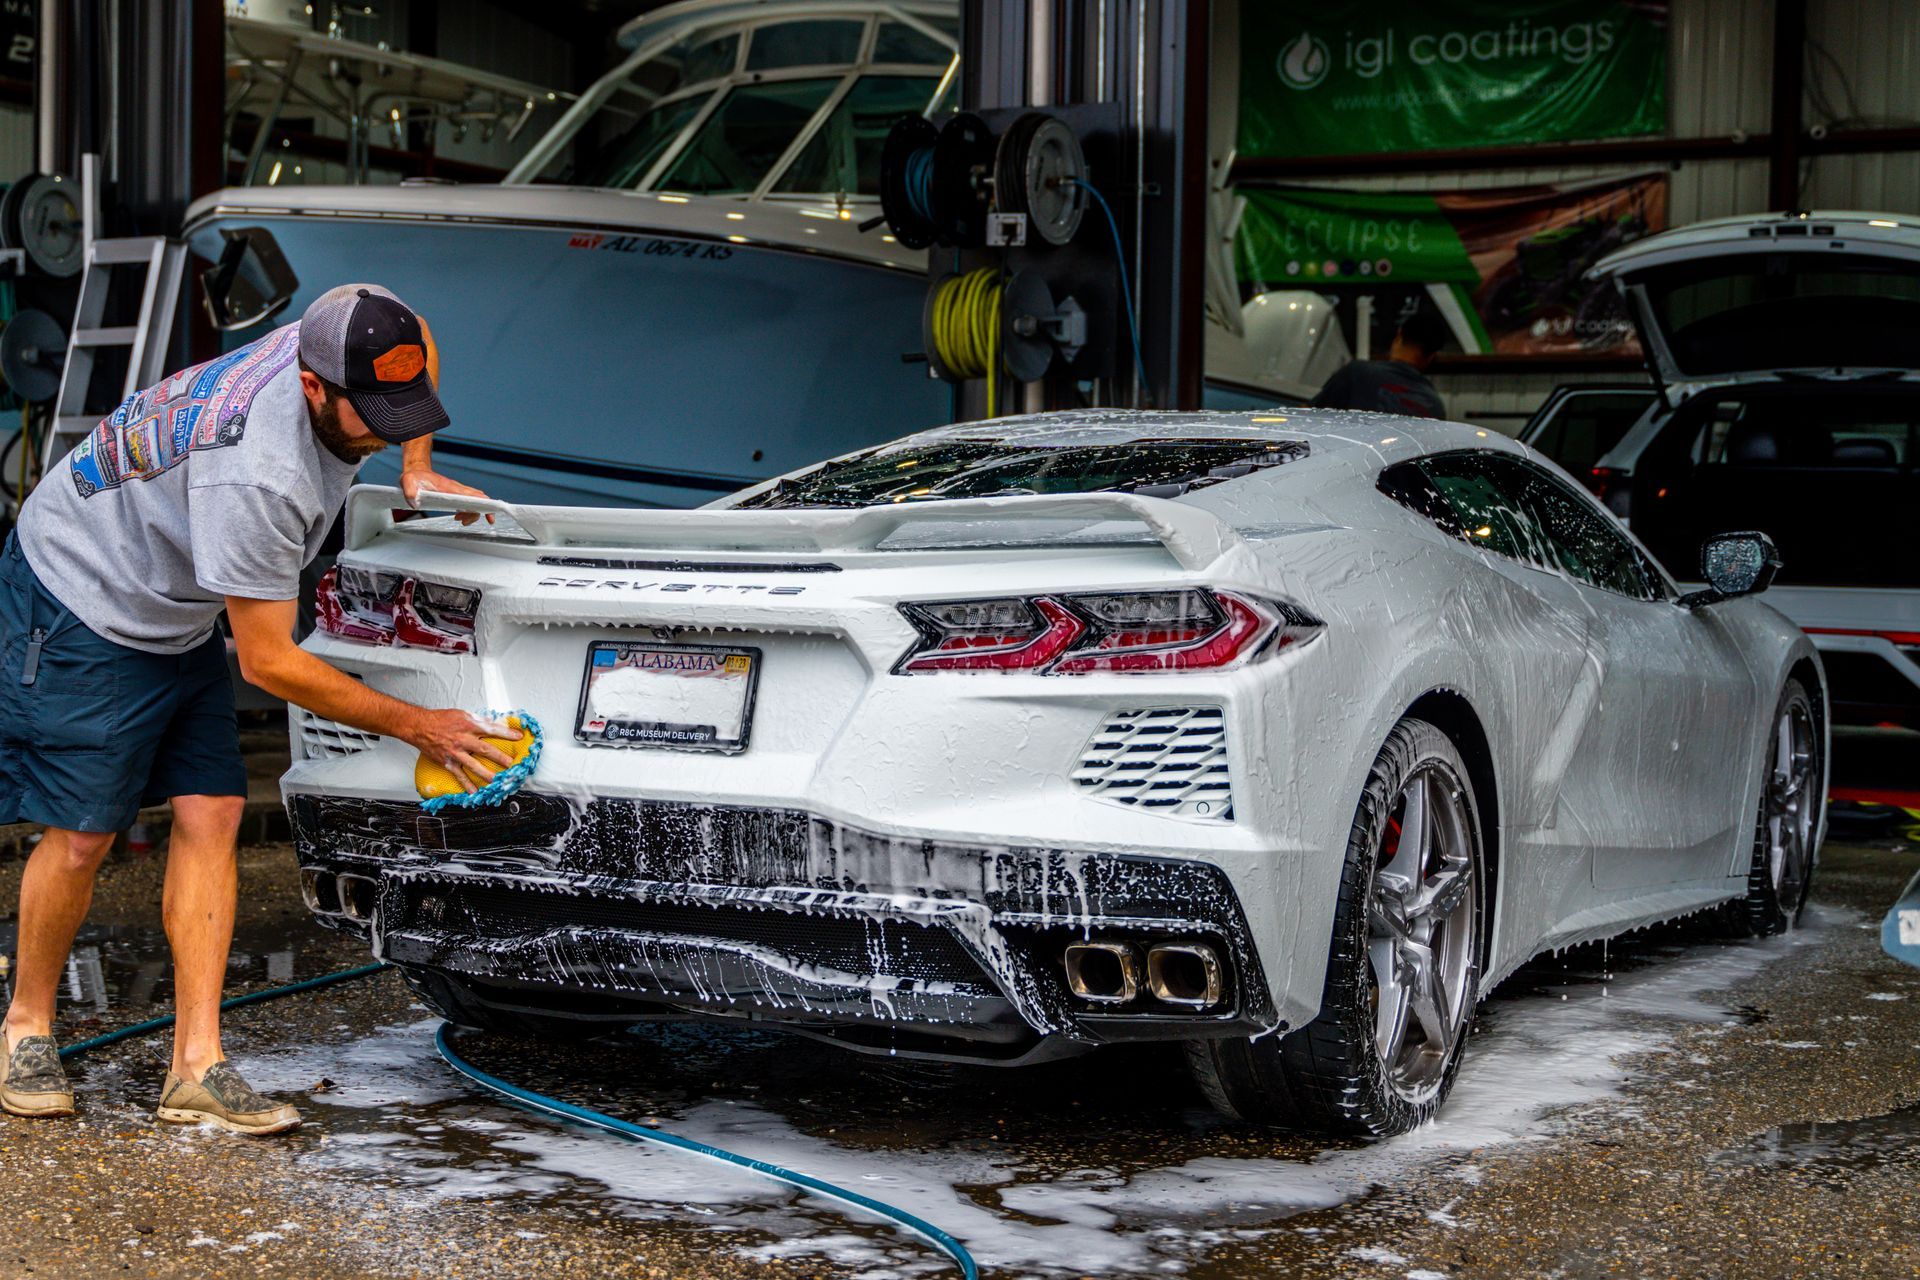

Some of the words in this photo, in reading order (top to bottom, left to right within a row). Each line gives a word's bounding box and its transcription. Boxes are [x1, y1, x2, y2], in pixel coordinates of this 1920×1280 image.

[1345, 27, 1394, 78] igl
[1408, 18, 1616, 65] coatings
[603, 236, 640, 251] AL
[643, 239, 700, 257] 0674
[1284, 219, 1421, 255] ECLIPSE
[538, 577, 806, 595] CORVETTE
[628, 653, 717, 671] ALABAMA
[620, 728, 635, 736] R8C
[636, 729, 670, 739] MUSEUM
[672, 731, 710, 740] DELIVERY
